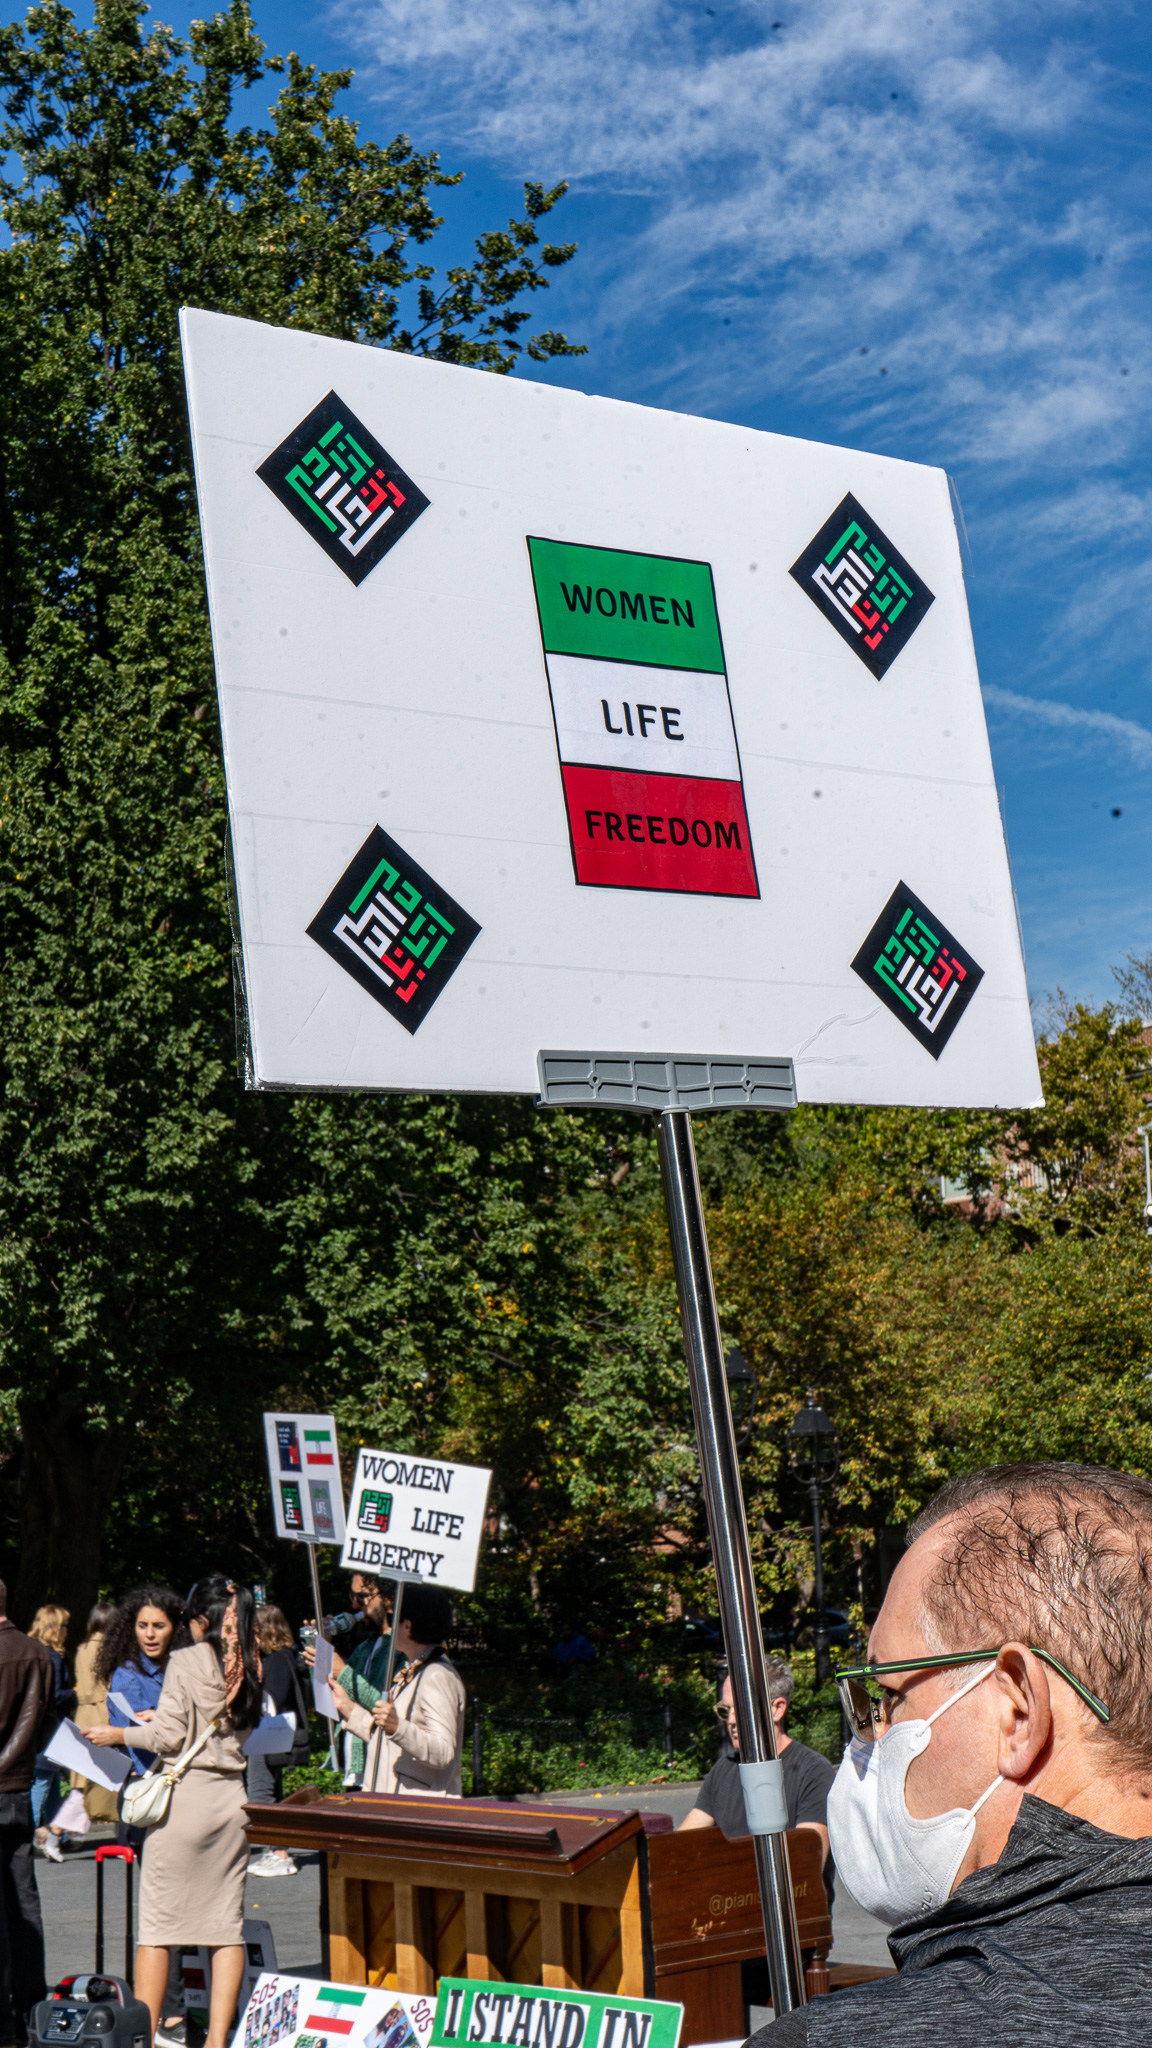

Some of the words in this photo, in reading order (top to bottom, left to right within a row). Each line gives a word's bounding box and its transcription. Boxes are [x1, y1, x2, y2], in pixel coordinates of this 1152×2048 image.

[559, 582, 696, 628] WOMEN
[601, 699, 685, 741] LIFE
[584, 810, 742, 850] FREEDOM
[362, 1455, 454, 1493] WOMEN
[411, 1507, 465, 1540] LIFE
[347, 1538, 444, 1577] LIBERTY
[248, 1977, 280, 2012] SOS
[410, 1998, 434, 2033] SOS
[443, 1989, 463, 2038] I
[470, 1992, 586, 2048] STAND
[602, 2008, 653, 2048] IN
